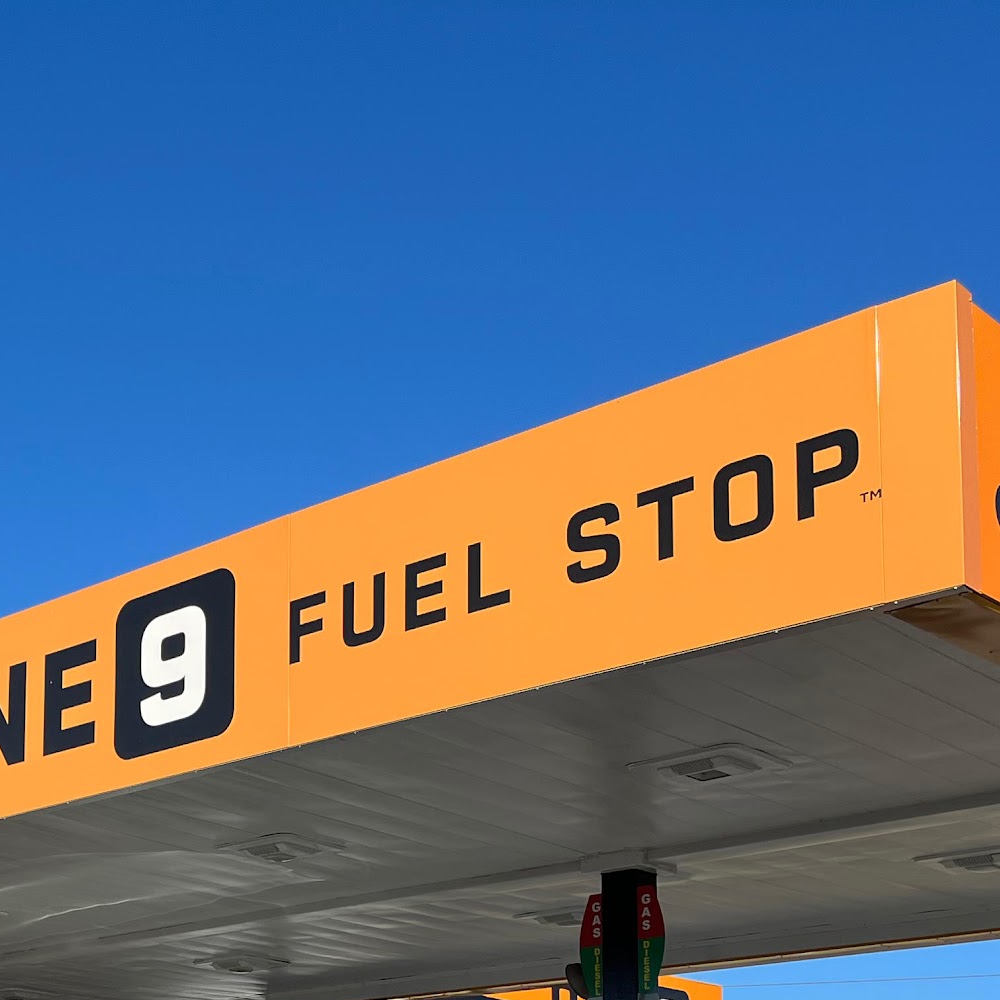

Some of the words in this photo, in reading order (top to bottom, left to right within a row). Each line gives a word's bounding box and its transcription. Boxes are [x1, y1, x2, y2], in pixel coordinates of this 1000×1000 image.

[289, 542, 511, 665] FUEL
[566, 428, 859, 584] STOP
[860, 489, 882, 503] TM
[591, 902, 601, 938] GAS
[641, 893, 651, 931] GAS
